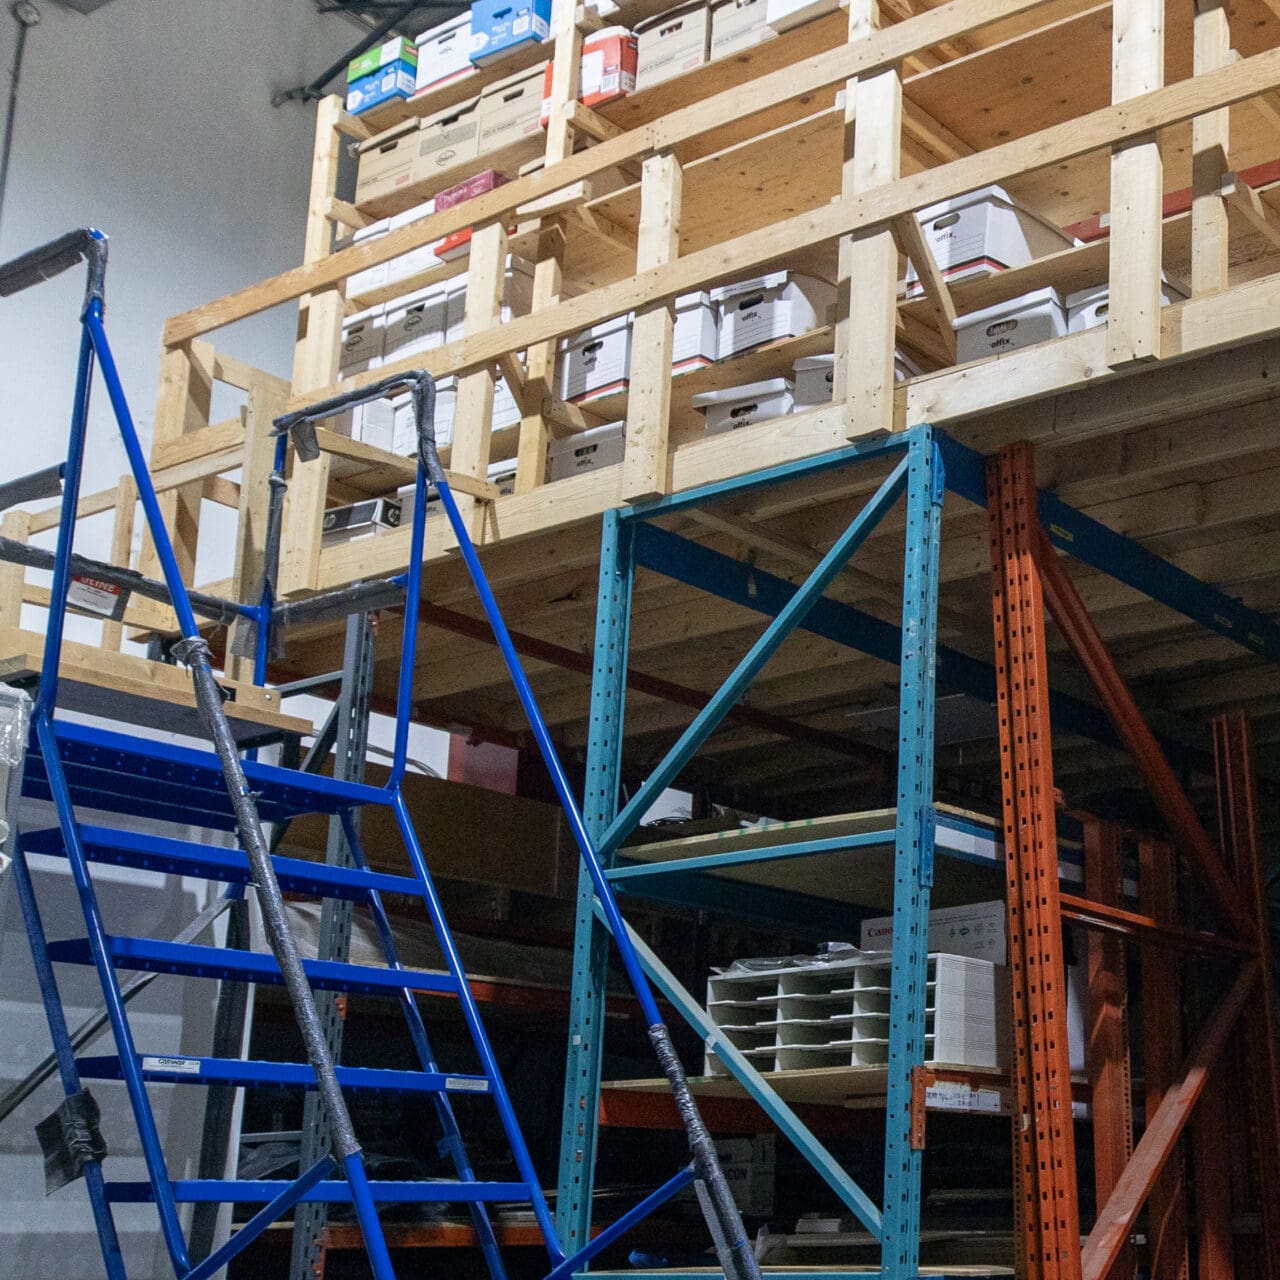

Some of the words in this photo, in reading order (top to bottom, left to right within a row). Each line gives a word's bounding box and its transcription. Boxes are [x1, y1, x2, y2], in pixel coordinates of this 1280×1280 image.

[990, 335, 1011, 350] offix
[80, 577, 116, 593] ULINE
[867, 927, 894, 938] Cano
